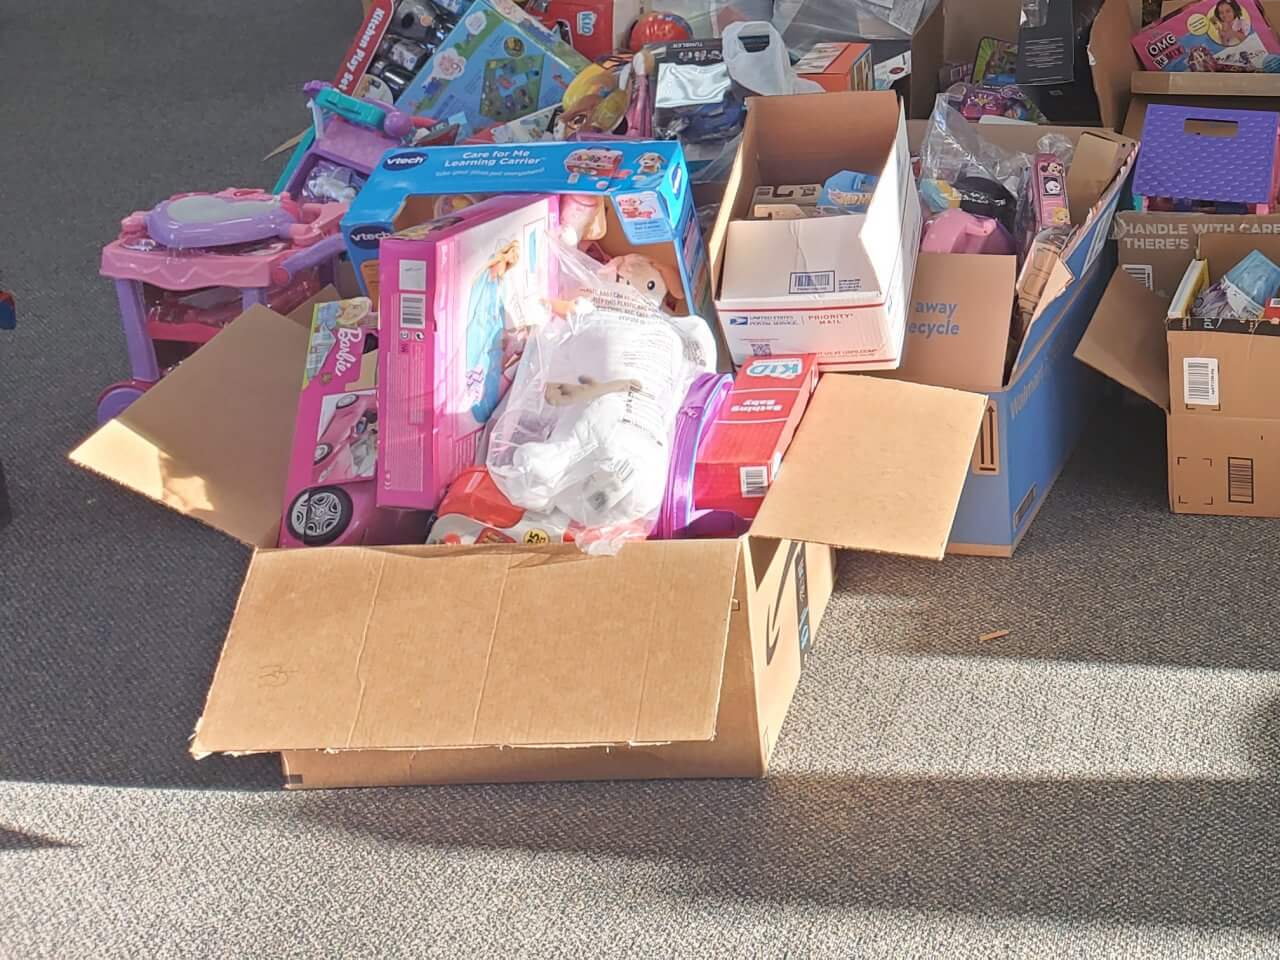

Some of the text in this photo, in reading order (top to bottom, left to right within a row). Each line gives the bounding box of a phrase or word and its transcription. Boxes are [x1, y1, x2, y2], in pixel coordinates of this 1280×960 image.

[582, 12, 593, 34] KID
[338, 7, 385, 91] Kitchen Play Set
[1149, 34, 1177, 57] OMG
[462, 149, 530, 159] Care for Me
[386, 156, 424, 166] vtech
[444, 159, 497, 168] Learning
[1123, 223, 1188, 235] HANDLE
[1192, 223, 1235, 234] WITH
[351, 231, 393, 242] vtech
[1123, 238, 1190, 250] THERE'S
[808, 313, 849, 321] PRIORITY
[915, 302, 958, 321] away
[908, 319, 960, 339] ecycle
[335, 326, 362, 377] Barbie
[749, 363, 799, 375] KID
[730, 404, 783, 413] Bathing
